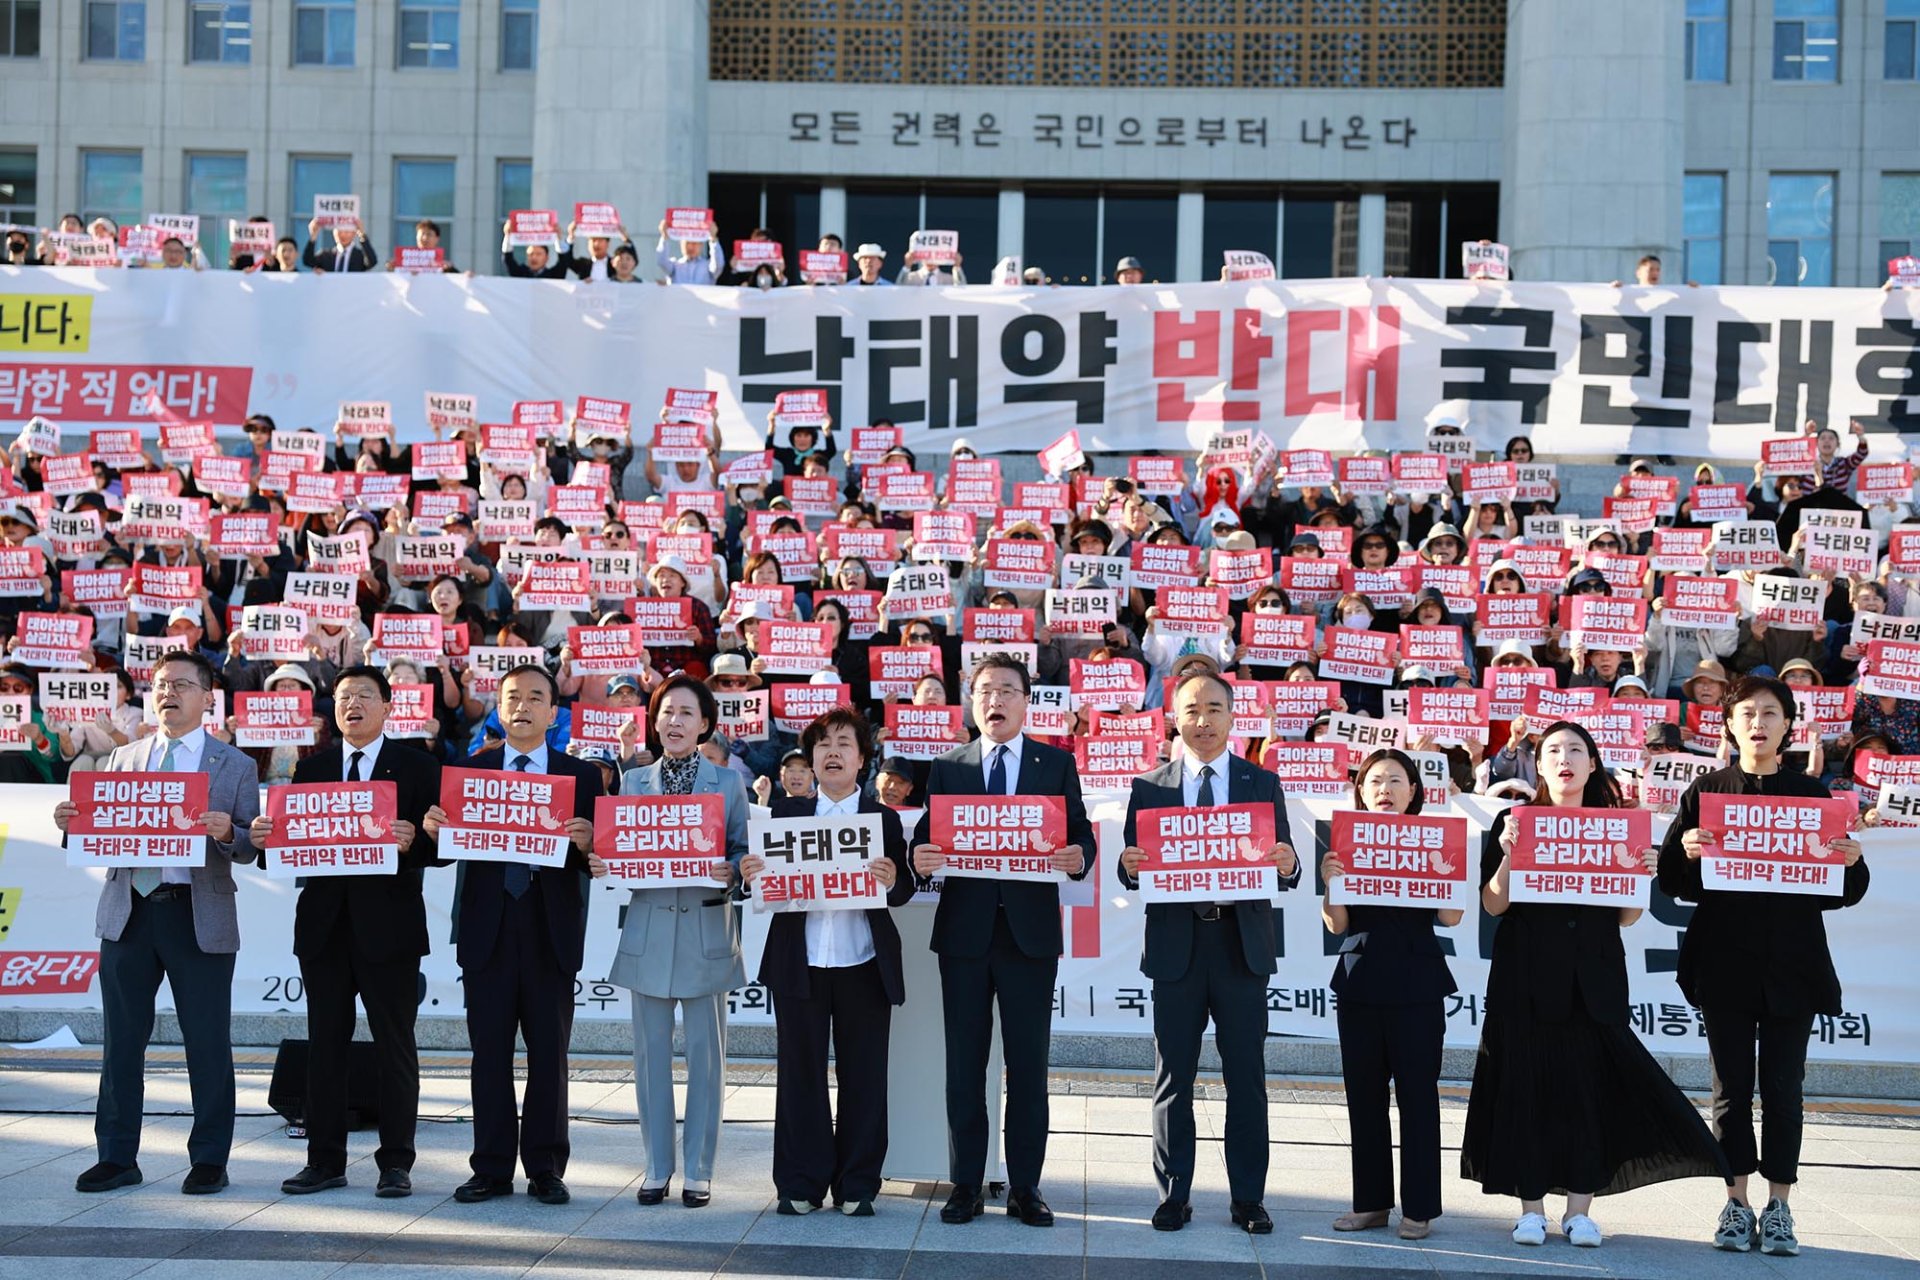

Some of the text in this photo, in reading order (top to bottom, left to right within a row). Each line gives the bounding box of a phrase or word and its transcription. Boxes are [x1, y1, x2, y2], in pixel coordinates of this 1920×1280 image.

[788, 112, 1417, 151] 모든 권력은 국민으로부터 나온다
[738, 310, 1118, 431] 낙태약
[1153, 307, 1400, 423] 반대
[79, 369, 118, 417] 적
[128, 371, 218, 418] 없다!
[430, 396, 471, 413] 낙태약
[1428, 440, 1471, 453] 낙태약
[130, 502, 182, 519] 낙태약
[484, 506, 531, 520] 낙태약
[222, 517, 268, 531] 태아생명
[156, 525, 185, 539] 반대
[839, 533, 885, 546] 태아생명
[1719, 527, 1776, 545] 낙태약
[1814, 531, 1871, 552] 낙태약
[402, 542, 456, 558] 낙태약
[997, 544, 1044, 557] 태아생명
[1142, 547, 1189, 561] 태아생명
[1716, 551, 1780, 566] 절대 반대
[1809, 554, 1872, 573] 절대 반대
[141, 569, 189, 583] 태아생명
[531, 566, 580, 580] 태아생명
[1292, 562, 1339, 575] 태아생명
[74, 586, 113, 600] 살리자!
[142, 581, 181, 596] 살리자!
[294, 580, 350, 599] 낙태약
[1676, 580, 1726, 595] 태아생명
[1762, 582, 1819, 604] 낙태약
[889, 595, 950, 613] 절대 반대
[1052, 596, 1109, 614] 낙태약
[1168, 591, 1217, 606] 태아생명
[1488, 598, 1538, 613] 태아생명
[1675, 594, 1716, 608] 살리자!
[322, 604, 350, 619] 반대
[1167, 605, 1209, 618] 살리자!
[1583, 601, 1635, 616] 태아생명
[27, 617, 80, 632] 태아생명
[247, 613, 301, 631] 낙태약
[635, 615, 674, 628] 살리자!
[975, 613, 1023, 626] 태아생명
[1488, 612, 1530, 625] 살리자!
[1582, 614, 1625, 629] 살리자!
[1790, 609, 1819, 625] 반대
[382, 619, 431, 632] 태아생명
[974, 626, 1014, 640] 살리자!
[1051, 620, 1078, 633] 절대
[1254, 618, 1304, 633] 태아생명
[26, 632, 70, 646] 살리자!
[382, 632, 424, 647] 살리자!
[579, 630, 630, 644] 태아생명
[771, 627, 821, 641] 태아생명
[1253, 632, 1294, 646] 살리자!
[1335, 634, 1386, 649] 태아생명
[244, 637, 304, 653] 절대 반대
[580, 643, 622, 657] 살리자!
[771, 640, 813, 654] 살리자!
[881, 651, 931, 665] 태아생명
[1335, 647, 1375, 662] 살리자!
[882, 665, 923, 678] 살리자!
[1082, 663, 1132, 676] 태아생명
[1327, 662, 1386, 678] 낙태약 반대!
[48, 681, 110, 700] 낙태약
[1082, 676, 1124, 690] 살리자!
[784, 687, 837, 702] 태아생명
[1422, 692, 1476, 707] 태아생명
[246, 697, 299, 710] 태아생명
[247, 711, 292, 725] 살리자!
[897, 710, 950, 724] 태아생명
[1032, 713, 1064, 728] 반대
[1422, 707, 1467, 722] 살리자!
[897, 724, 940, 738] 살리자!
[1336, 720, 1399, 747] 낙태약
[1088, 740, 1143, 755] 태아생명
[1277, 747, 1334, 762] 태아생명
[1088, 757, 1134, 772] 살리자!
[1277, 763, 1324, 778] 살리자!
[93, 780, 186, 804] 태아생명
[463, 778, 552, 804] 태아생명
[286, 791, 374, 815] 태아생명
[92, 805, 168, 830] 살리자!
[462, 802, 535, 827] 살리자!
[615, 804, 703, 827] 태아생명
[952, 805, 1044, 829] 태아생명
[1724, 804, 1822, 831] 태아생명
[286, 815, 359, 839] 살리자!
[1160, 811, 1251, 837] 태아생명
[1534, 816, 1628, 841] 태아생명
[615, 827, 688, 852] 살리자!
[952, 828, 1027, 852] 살리자!
[1353, 822, 1444, 849] 태아생명
[1723, 830, 1803, 856] 살리자!
[83, 836, 191, 858] 낙태약 반대!
[452, 830, 556, 857] 낙태약 반대!
[763, 826, 871, 864] 낙태약
[1160, 836, 1236, 863] 살리자!
[281, 846, 384, 867] 낙태약 반대!
[1352, 848, 1428, 873] 살리자!
[1534, 842, 1612, 867] 살리자!
[609, 861, 713, 880] 낙태약 반대!
[946, 857, 1052, 874] 낙태약 반대!
[1715, 860, 1828, 885] 낙태약 반대!
[760, 870, 877, 902] 절대 반대
[1154, 870, 1263, 892] 낙태약 반대!
[1524, 874, 1636, 896] 낙태약 반대!
[1344, 878, 1452, 900] 낙태약 반대!
[1, 955, 95, 986] 없다!
